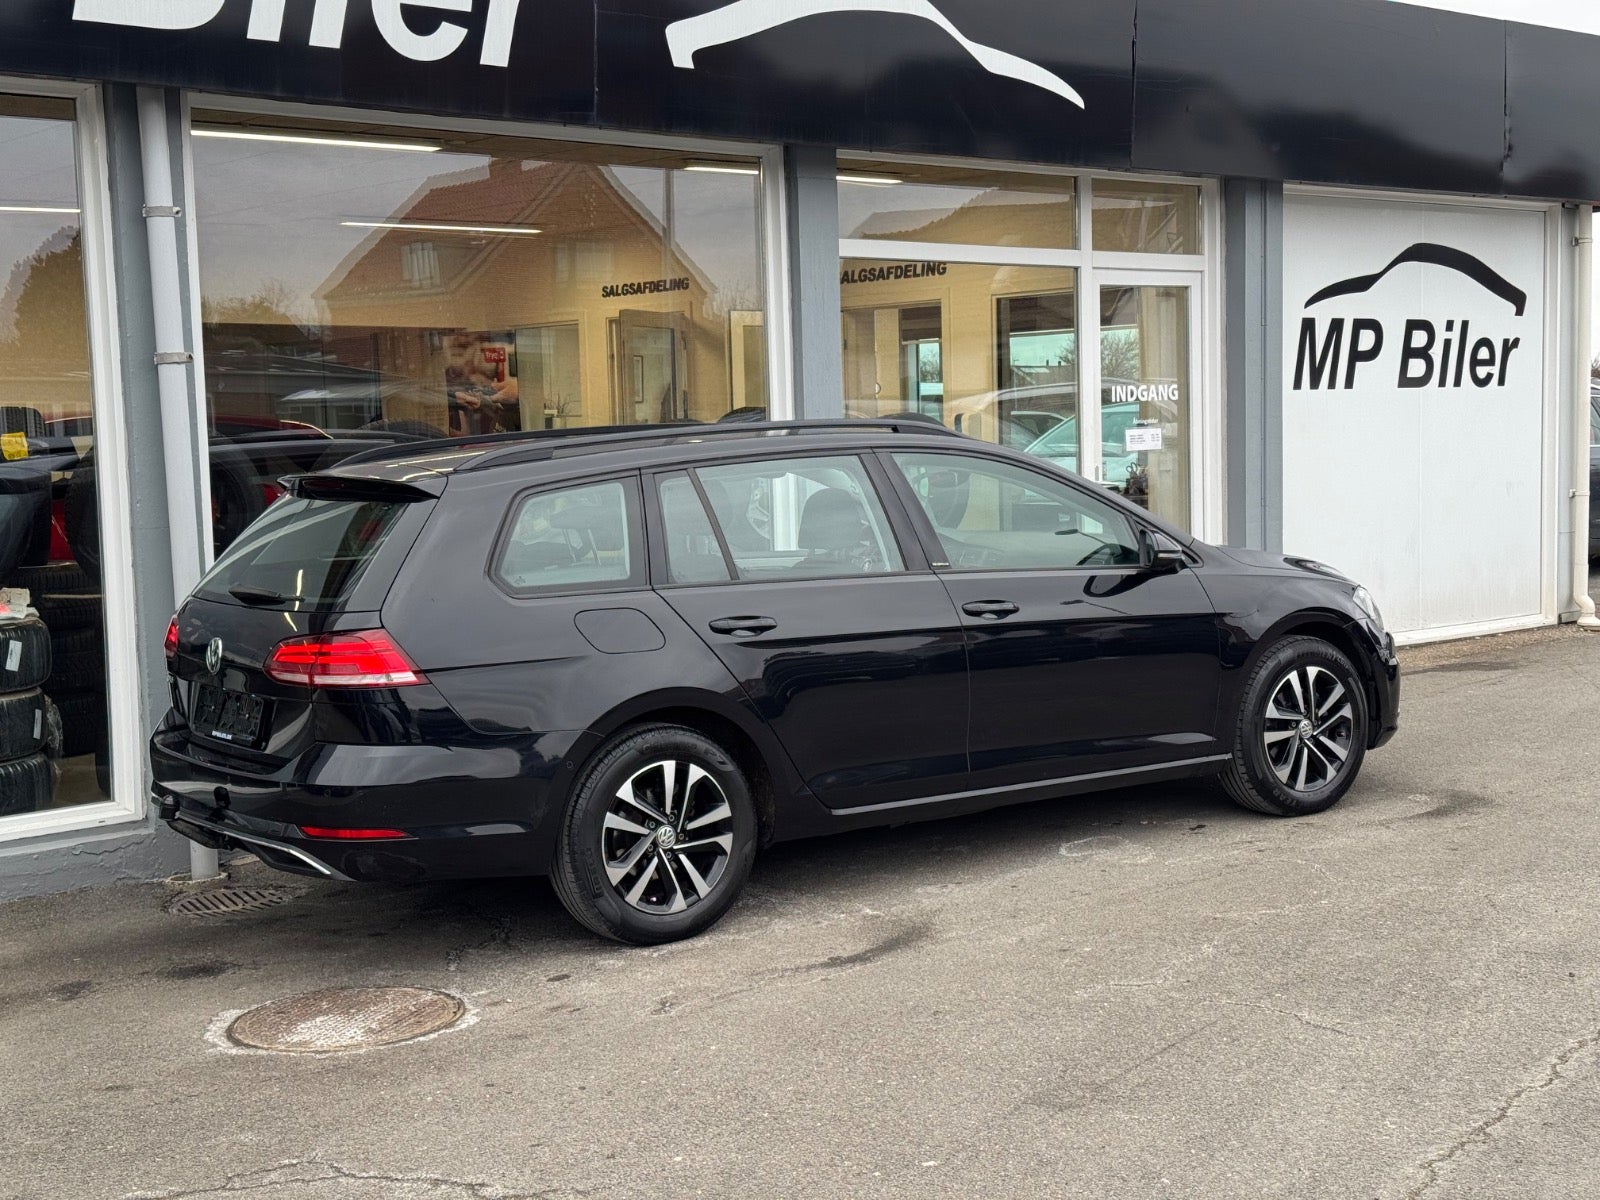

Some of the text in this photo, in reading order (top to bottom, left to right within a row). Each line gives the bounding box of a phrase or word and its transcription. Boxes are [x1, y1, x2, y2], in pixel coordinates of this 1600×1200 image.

[840, 262, 947, 285] ALGSAFDELING
[601, 277, 690, 298] SALGSAFDELING
[1293, 317, 1521, 390] MP Biler
[1111, 384, 1179, 402] INDGANG
